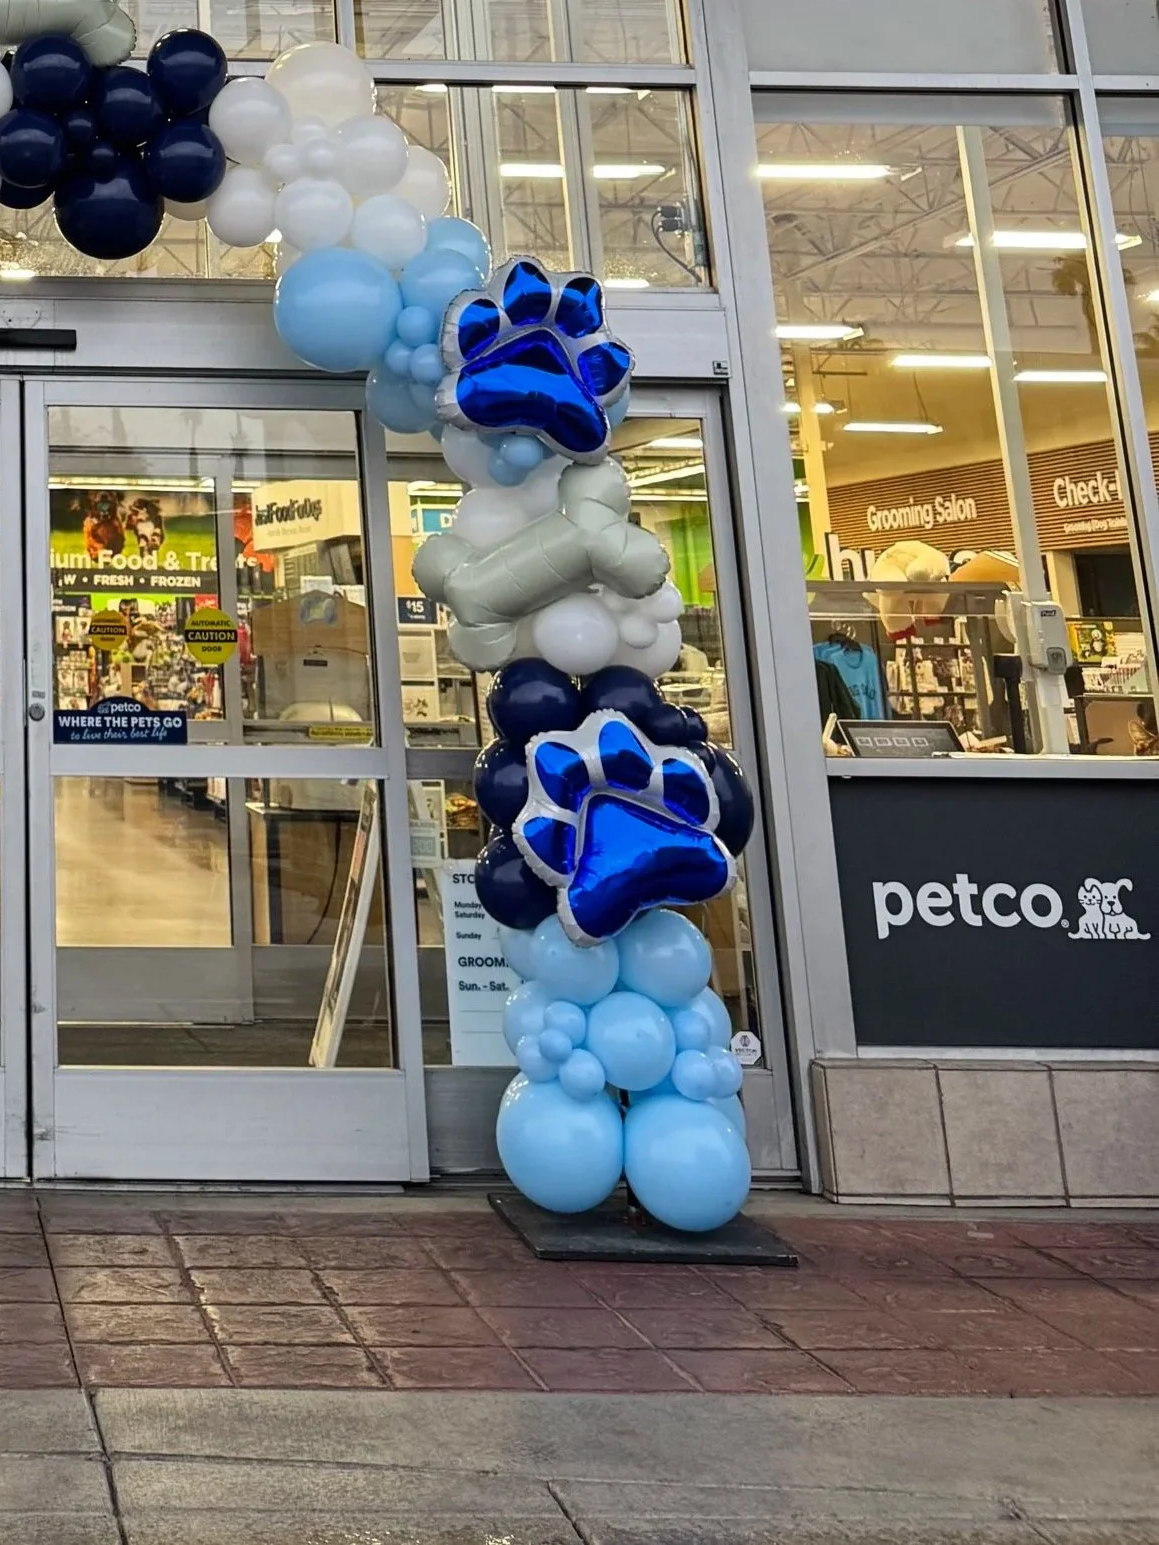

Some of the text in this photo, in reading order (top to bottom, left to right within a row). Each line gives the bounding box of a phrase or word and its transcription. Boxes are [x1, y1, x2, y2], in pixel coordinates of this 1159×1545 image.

[867, 493, 978, 532] Grooming Salon
[98, 550, 158, 571] Food
[163, 552, 181, 571] &
[93, 574, 201, 588] FRESH FROZEN
[406, 600, 424, 613] $15
[190, 619, 231, 628] AUTOMATIC
[91, 626, 125, 635] CAUTION
[187, 631, 235, 642] CAUTION
[201, 645, 222, 653] DOOR
[110, 702, 142, 714] petco
[58, 716, 183, 728] WHERE THE PETS GO
[70, 726, 168, 741] to live their best life
[454, 901, 482, 910] Monday
[872, 873, 1064, 940] petco
[454, 911, 486, 920] Saturday
[456, 931, 482, 941] Sunday
[458, 980, 481, 992] Sun.
[489, 980, 510, 992] Sat.
